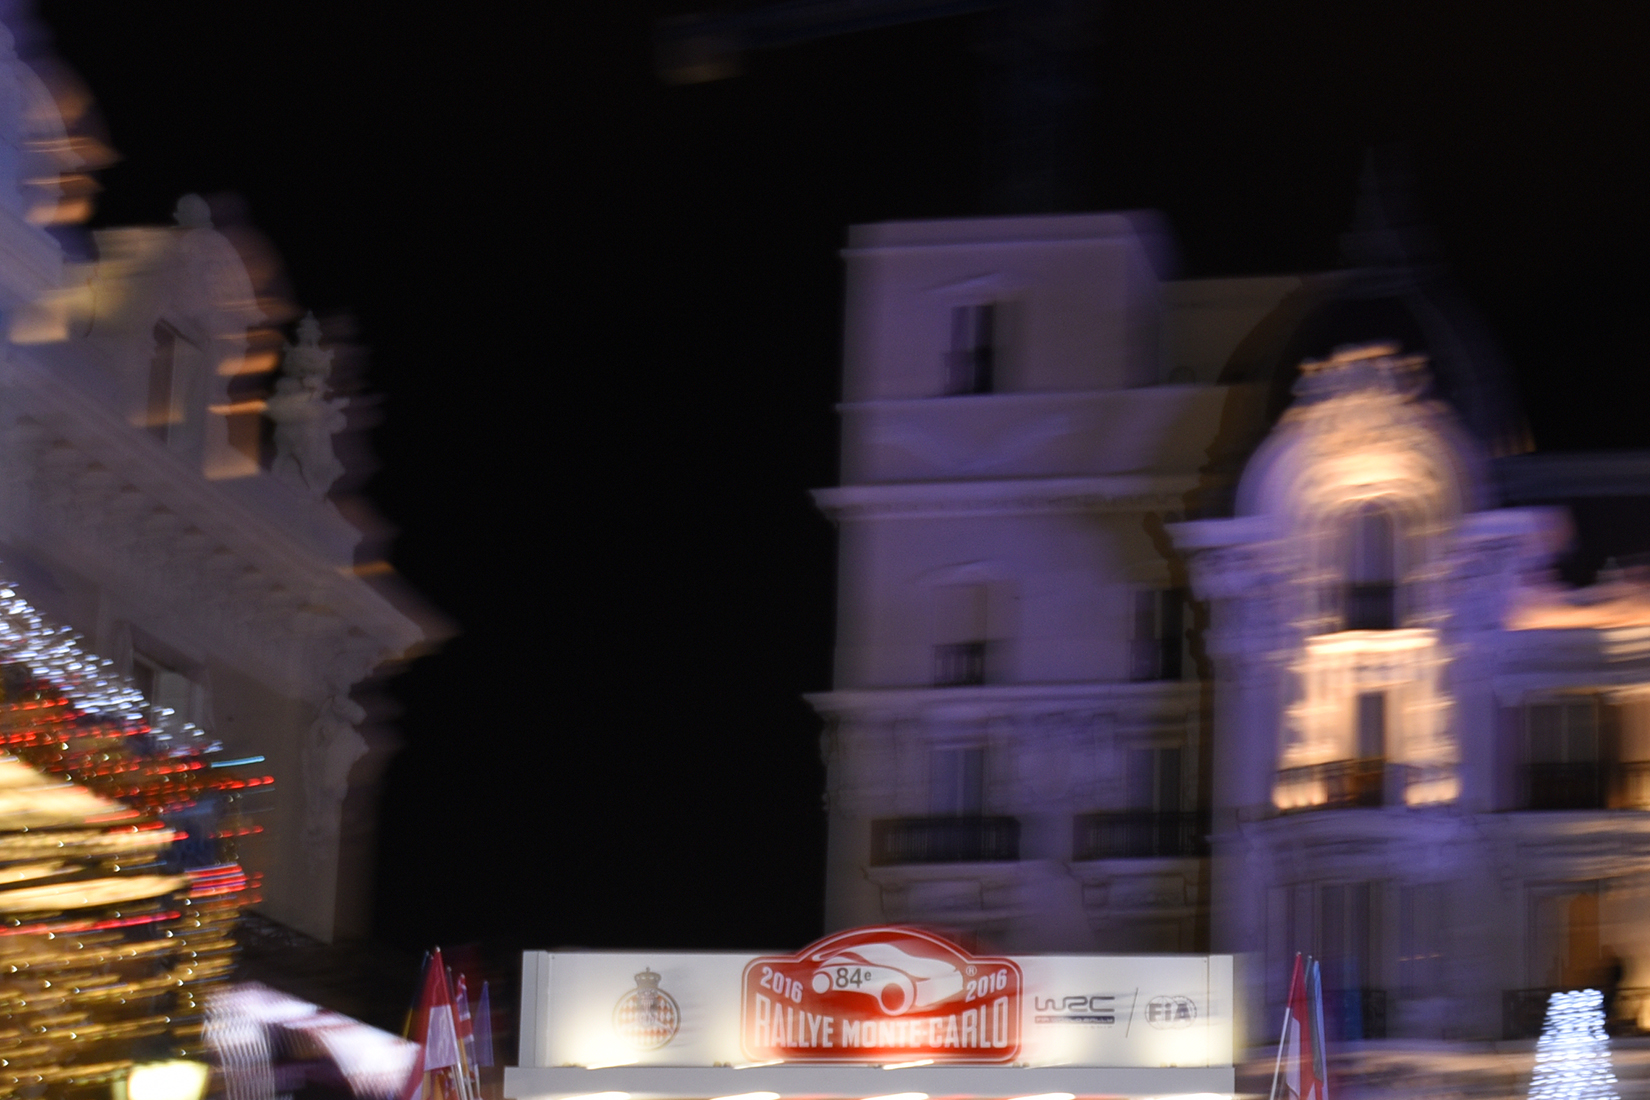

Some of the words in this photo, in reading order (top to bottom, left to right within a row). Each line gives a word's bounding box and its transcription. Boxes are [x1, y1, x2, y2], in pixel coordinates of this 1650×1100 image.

[760, 966, 803, 1004] 2016
[965, 968, 1007, 1003] 2016
[755, 993, 834, 1048] RALLYE
[1035, 995, 1115, 1013] WRC
